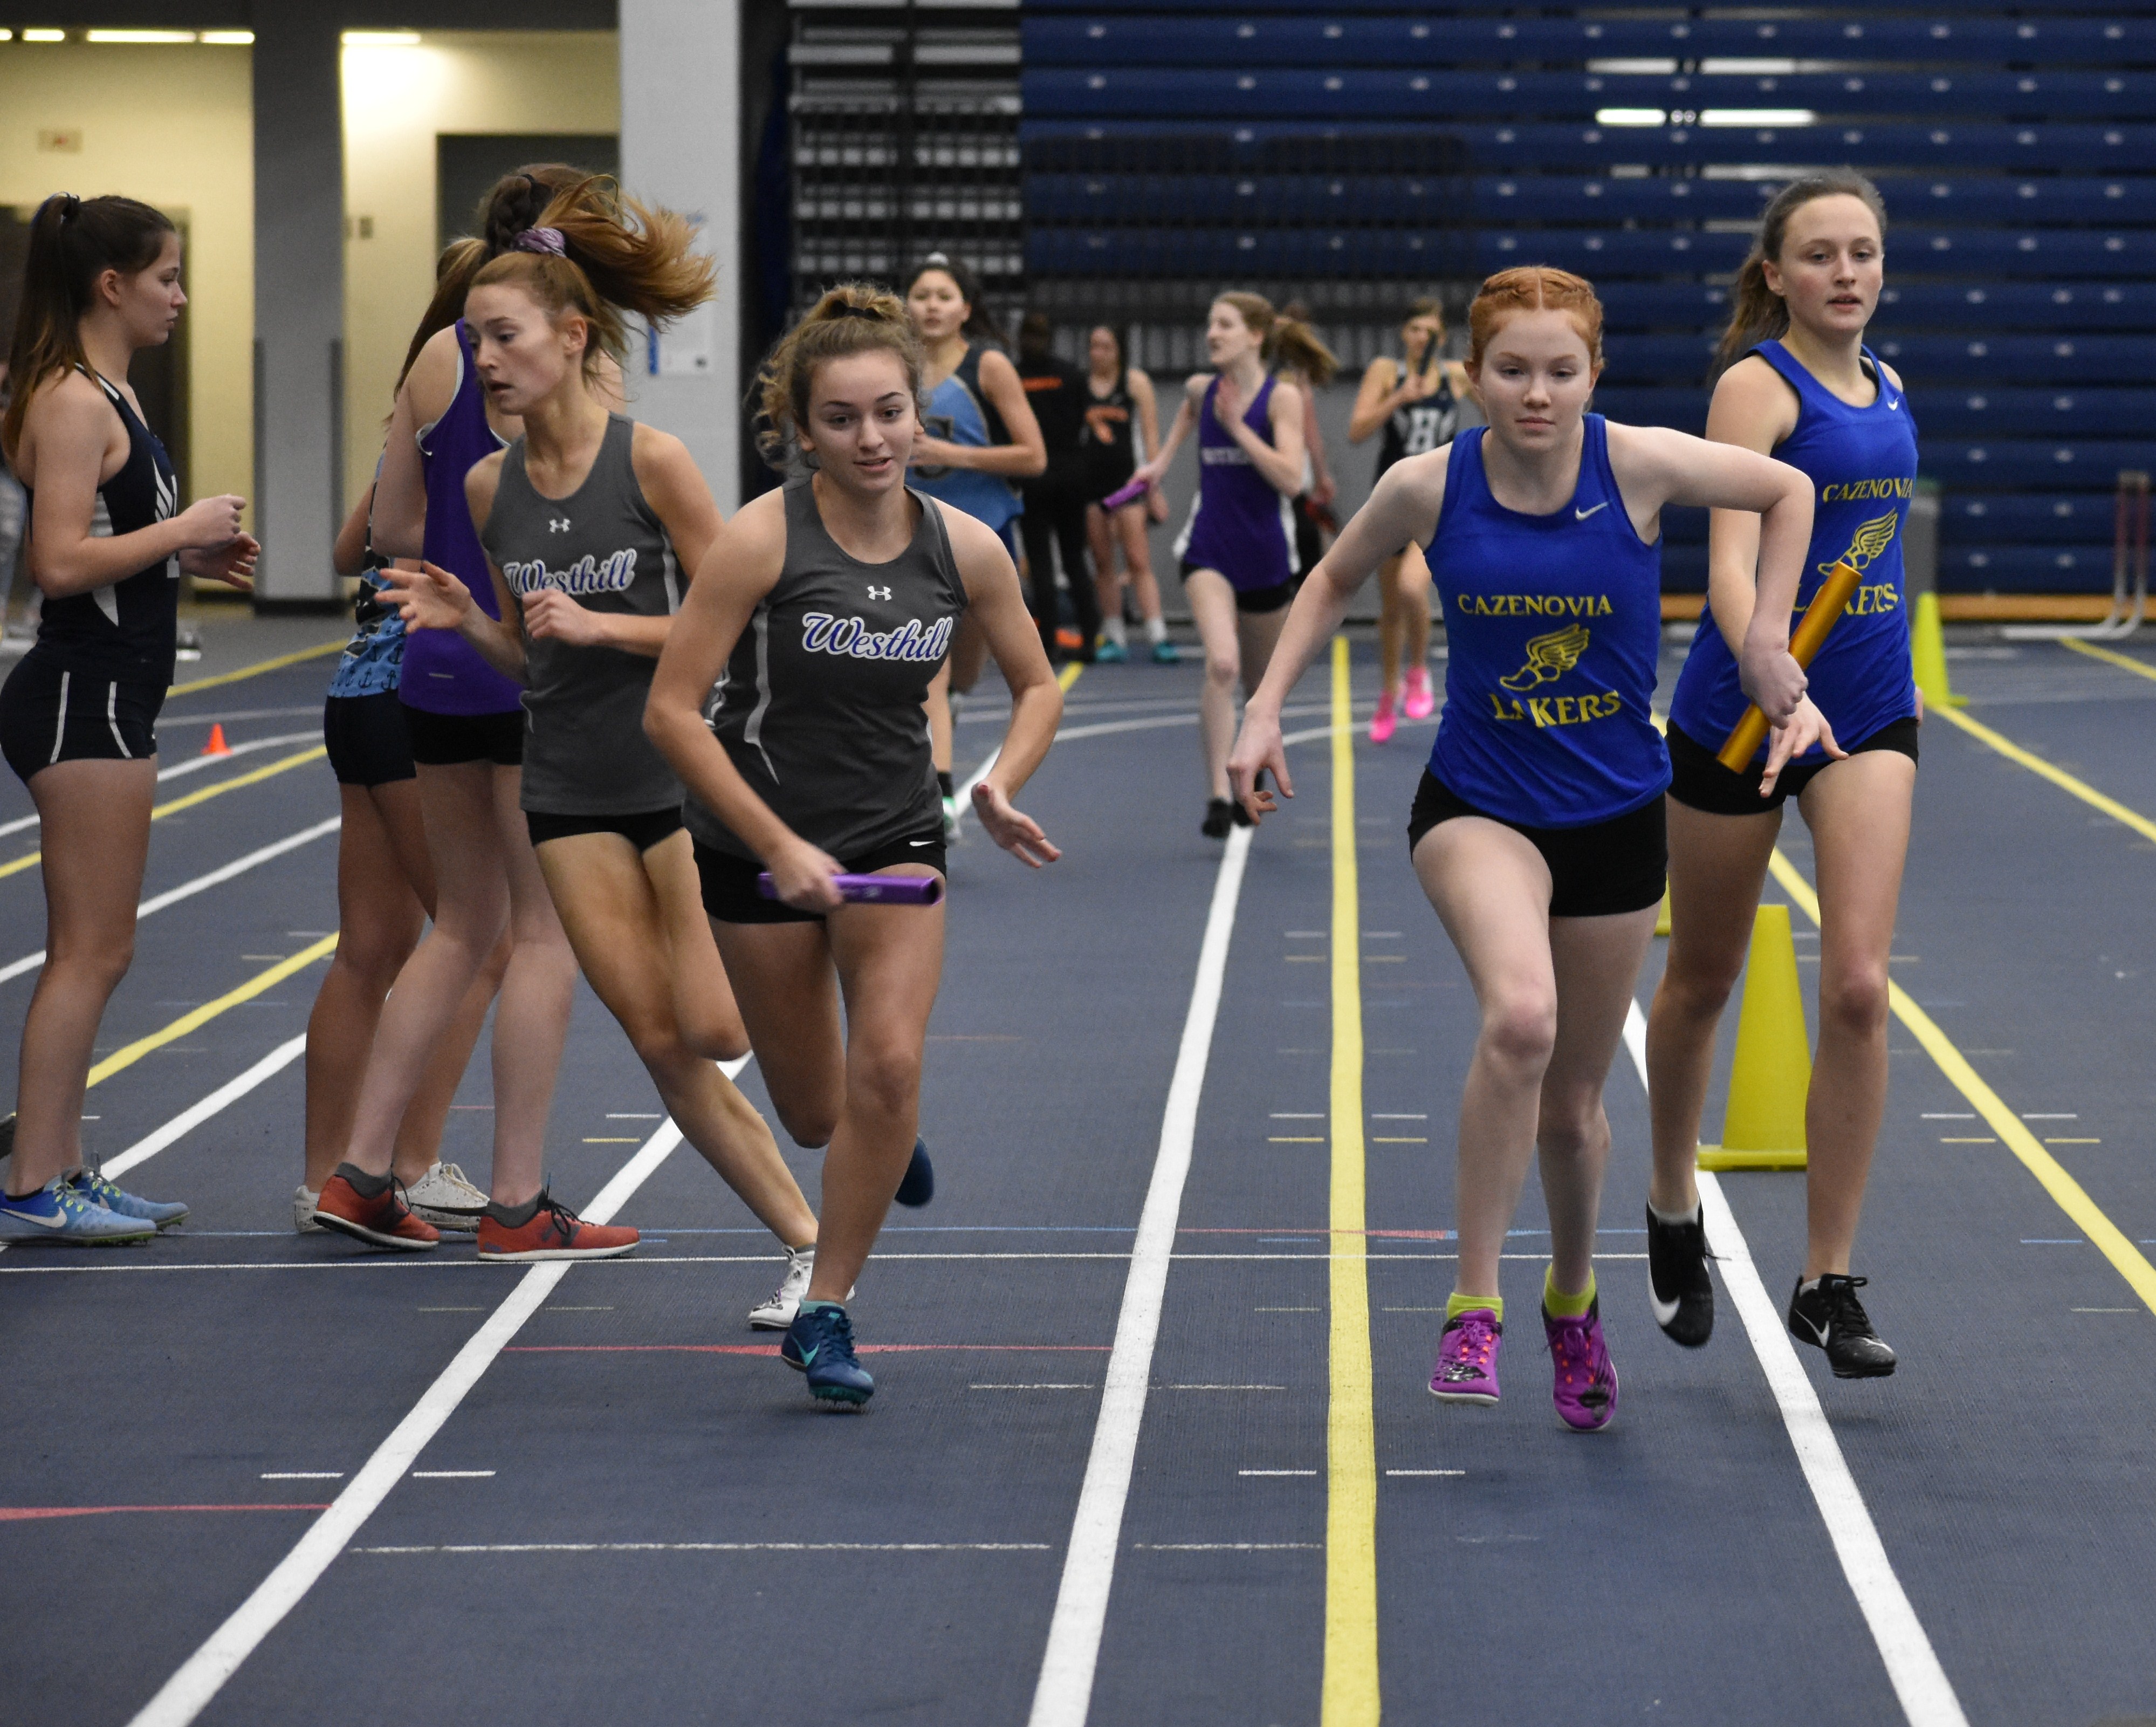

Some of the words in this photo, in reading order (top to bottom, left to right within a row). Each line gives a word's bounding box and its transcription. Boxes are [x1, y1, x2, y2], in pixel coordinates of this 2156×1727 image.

[1823, 477, 1913, 503] CAZENOVIA
[503, 547, 637, 599] Westhill
[1458, 594, 1613, 616] CAZENOVIA
[1793, 582, 1899, 615] LERS
[802, 612, 953, 661] Westhill
